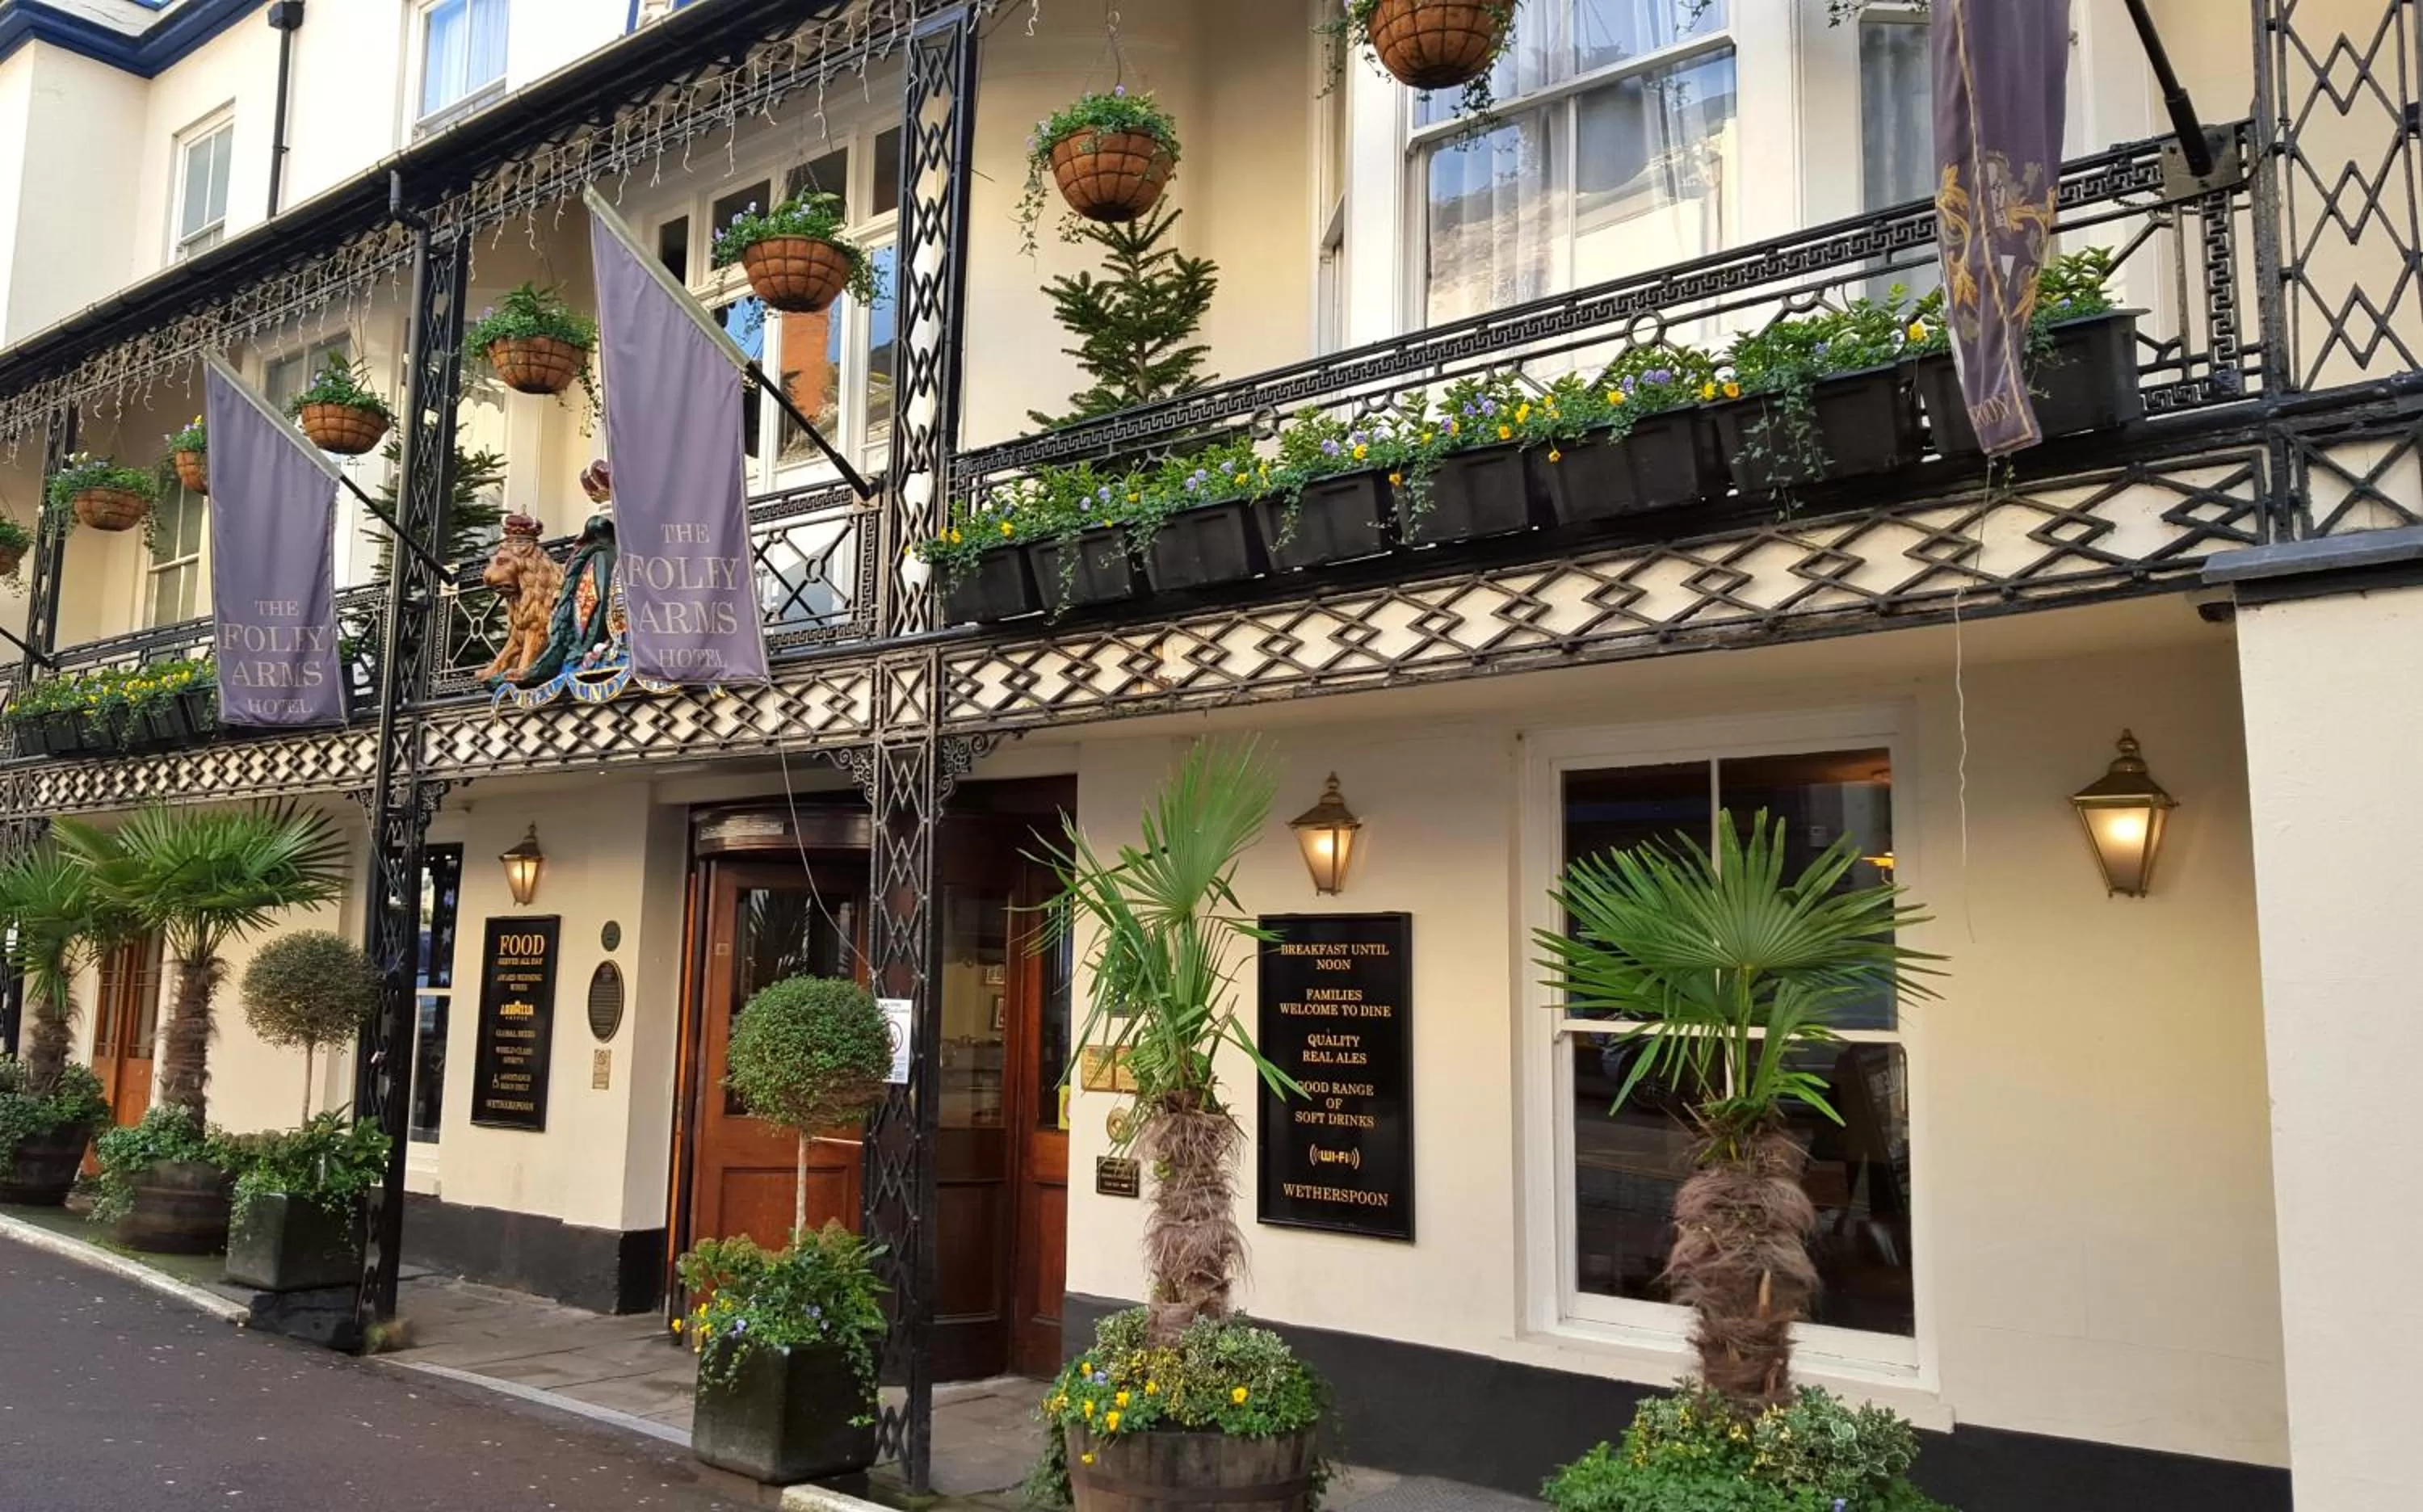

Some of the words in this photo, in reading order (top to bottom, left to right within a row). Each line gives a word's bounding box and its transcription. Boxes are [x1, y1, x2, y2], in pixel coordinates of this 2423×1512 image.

[661, 523, 711, 544] THE
[254, 600, 300, 616] THE
[638, 600, 737, 634] ARMS
[658, 649, 728, 668] HOTEL
[232, 660, 323, 688] ARMS
[247, 698, 313, 714] HOTEL
[498, 934, 545, 956] FOOD
[1280, 943, 1349, 956] BREAKFAST
[1351, 943, 1390, 956] UNTIL
[1316, 959, 1352, 970] NOON
[1306, 989, 1363, 1001] FAMILIES
[1279, 1003, 1338, 1015] WELCOME
[1341, 1004, 1358, 1016] TO
[1360, 1006, 1392, 1018] DINE
[1308, 1034, 1361, 1047] QUALITY
[1303, 1050, 1333, 1063] REAL
[1336, 1052, 1367, 1065] ALES
[1295, 1081, 1329, 1093] GOOD
[1333, 1082, 1374, 1096] RANGE
[1325, 1098, 1343, 1110] OF
[1295, 1111, 1325, 1124] SOFT
[1329, 1113, 1375, 1127] DRINKS
[1283, 1182, 1388, 1207] WETHERSPOON
